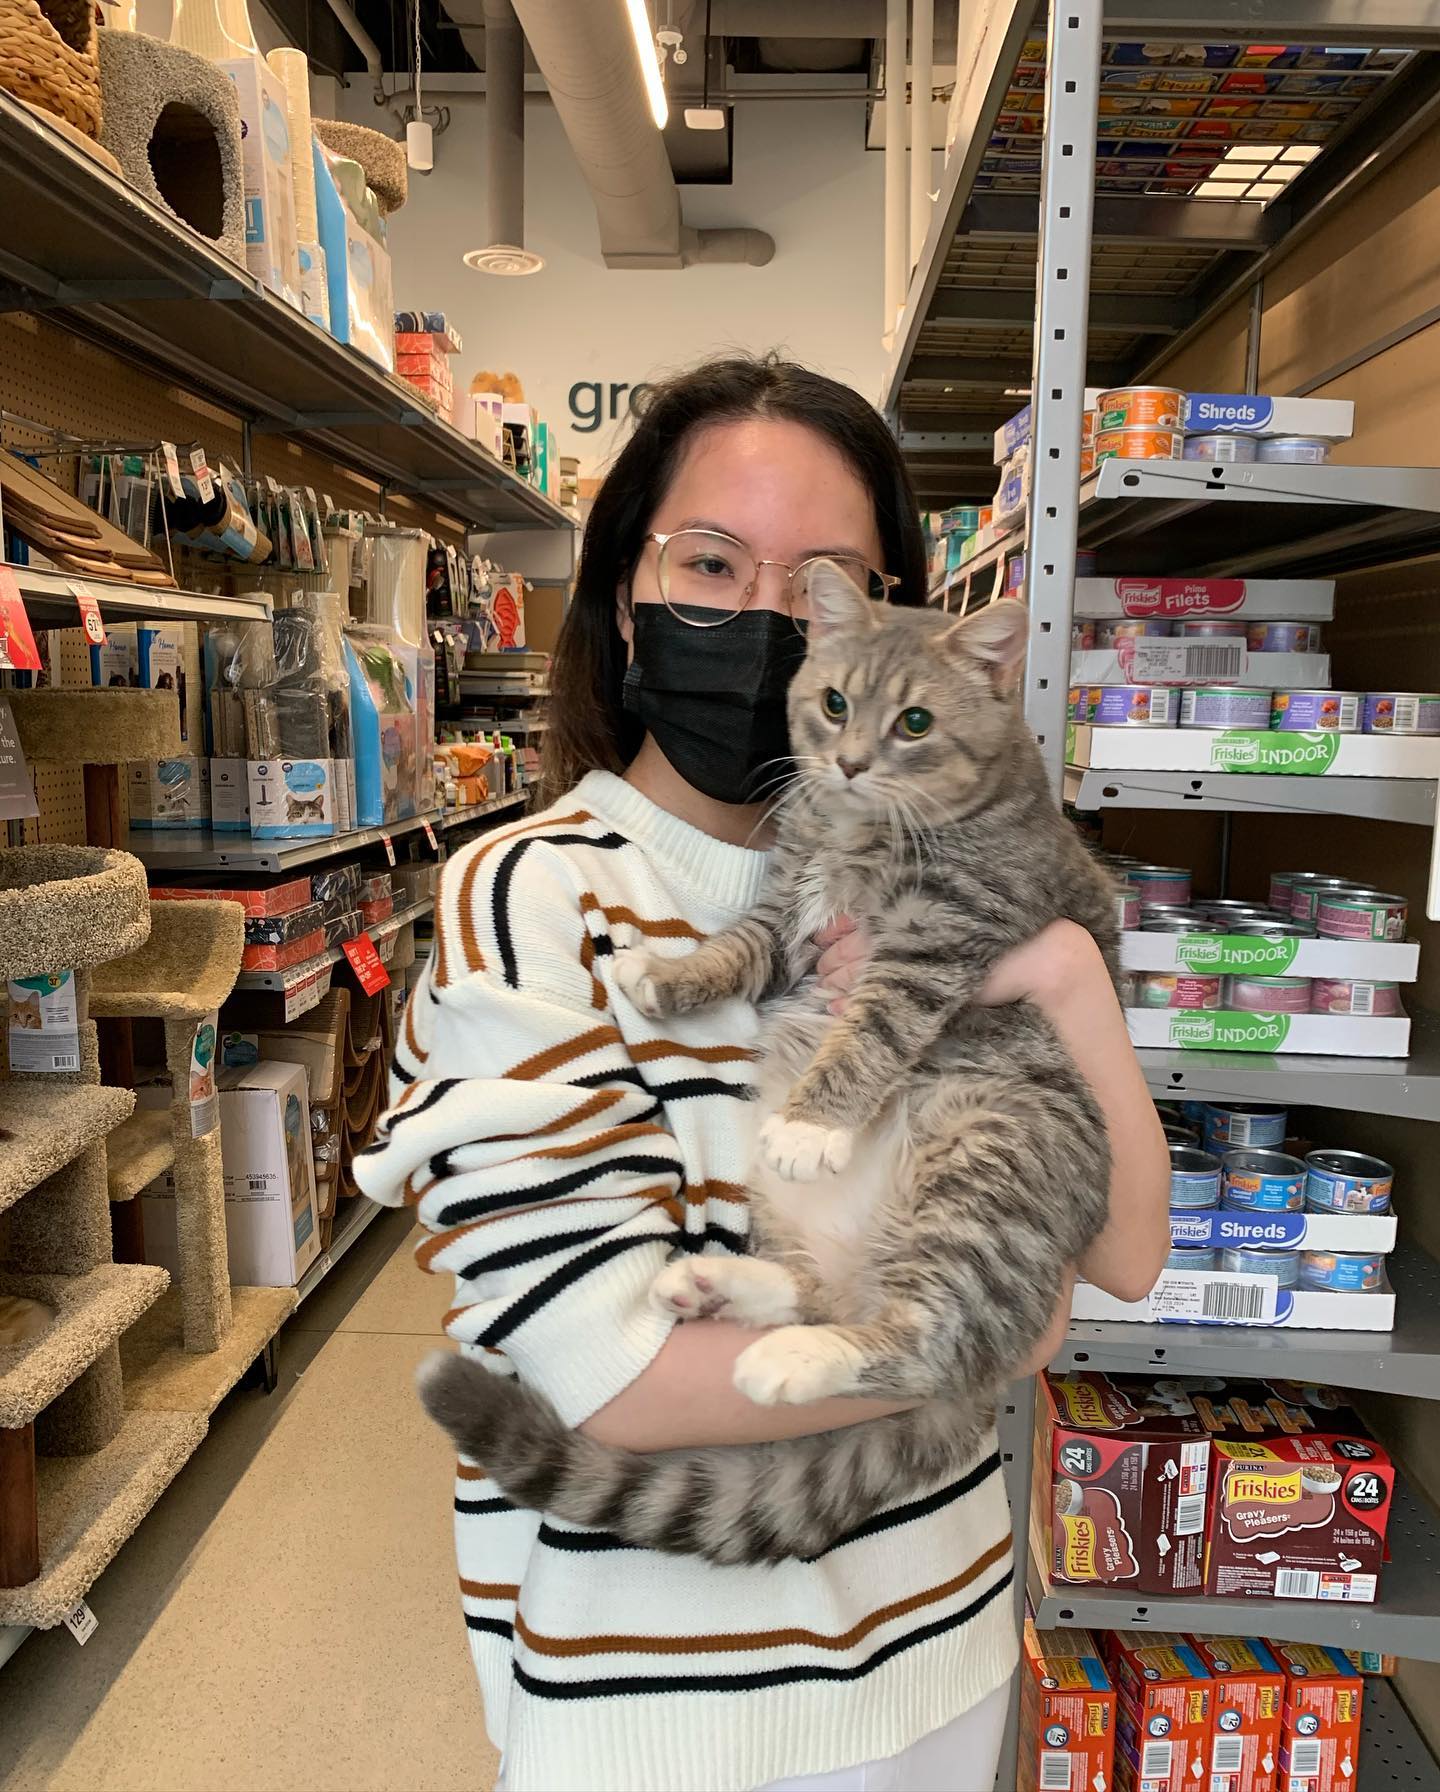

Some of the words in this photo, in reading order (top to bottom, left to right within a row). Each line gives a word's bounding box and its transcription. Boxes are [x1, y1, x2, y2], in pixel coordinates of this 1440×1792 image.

[1199, 403, 1256, 421] Shreds
[1124, 592, 1158, 604] Friskies
[1165, 594, 1210, 610] Filets
[1214, 747, 1255, 761] Friskies
[1261, 745, 1329, 765] INDOOR
[1178, 943, 1218, 960] Friskies
[1223, 946, 1289, 964] INDOOR
[1171, 1025, 1210, 1039] Friskies
[1216, 1024, 1281, 1042] INDOOR
[1171, 1224, 1208, 1238] Friskies
[1220, 1221, 1287, 1239] Shreds
[1072, 1385, 1104, 1423] Friskies
[1065, 1447, 1086, 1471] 24
[1233, 1479, 1296, 1499] Friskies
[1353, 1478, 1379, 1497] 24
[1236, 1509, 1266, 1521] Gravy
[1244, 1514, 1289, 1528] Pleasers
[1070, 1520, 1091, 1574] Friskies
[1106, 1528, 1123, 1565] Pleasers
[1102, 1547, 1116, 1572] Gravy
[70, 1609, 85, 1629] 129
[1158, 1722, 1168, 1733] 12
[1229, 1716, 1238, 1728] 12
[1307, 1720, 1316, 1732] 12
[1055, 1732, 1066, 1744] 12
